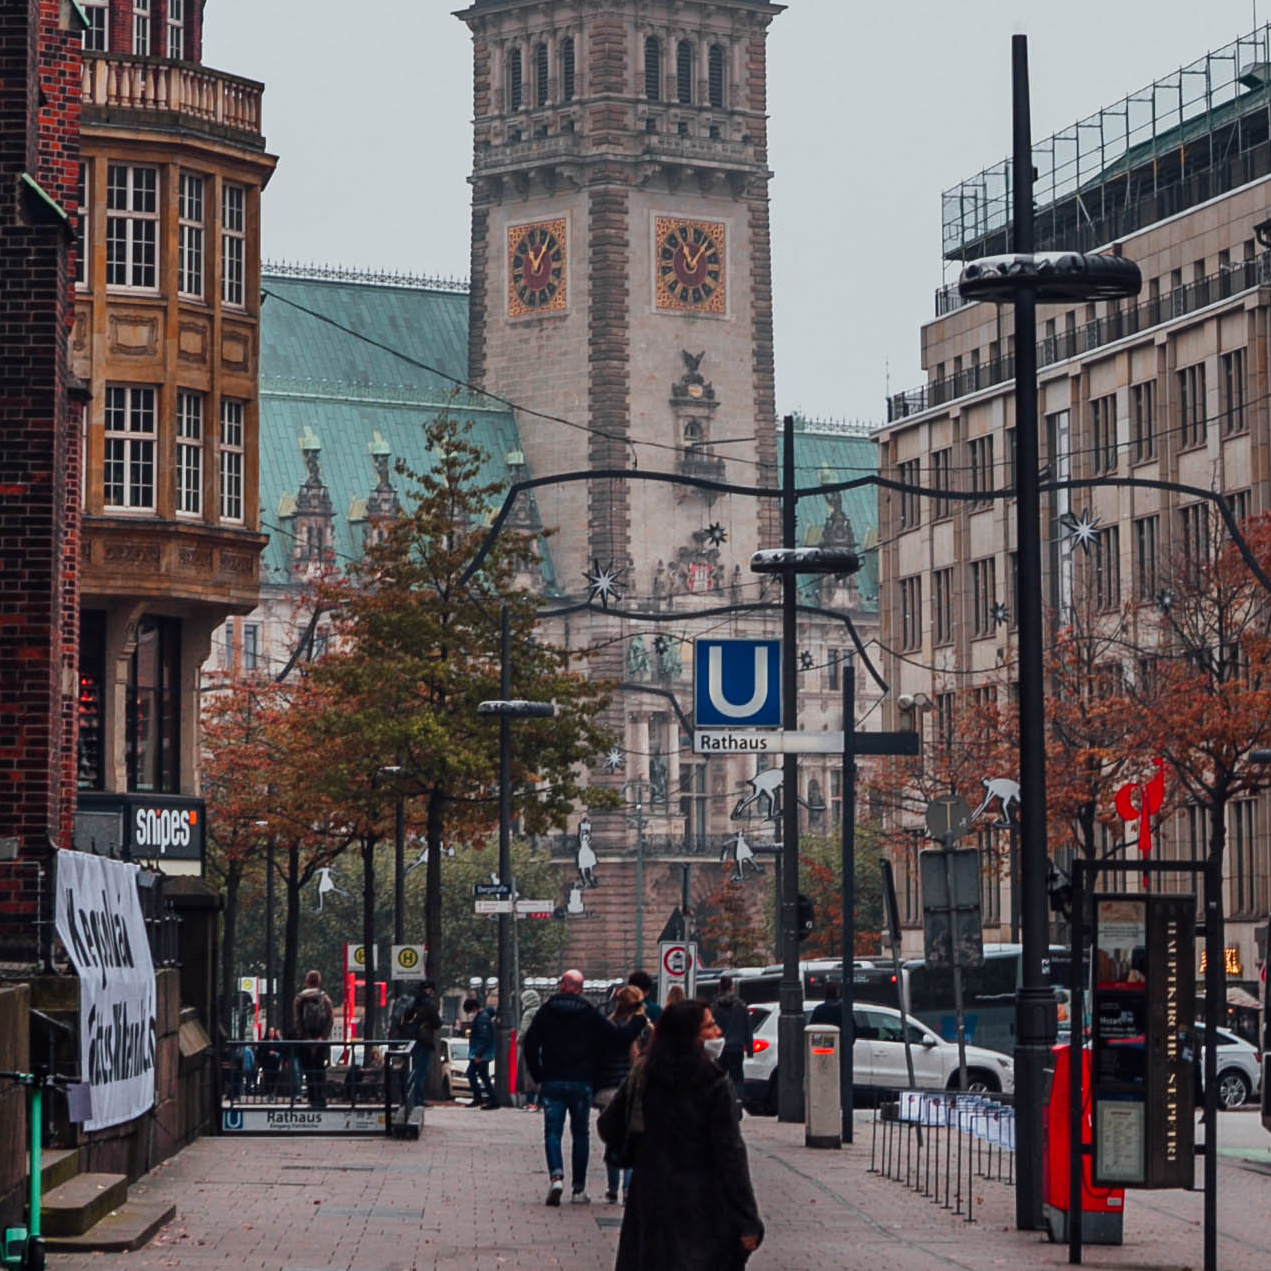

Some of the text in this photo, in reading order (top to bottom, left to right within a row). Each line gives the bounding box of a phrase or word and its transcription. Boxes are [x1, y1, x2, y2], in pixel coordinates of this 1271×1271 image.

[709, 646, 769, 718] U
[701, 734, 767, 750] Rathaus
[136, 808, 191, 853] snipes
[228, 1111, 322, 1128] U Rathaus
